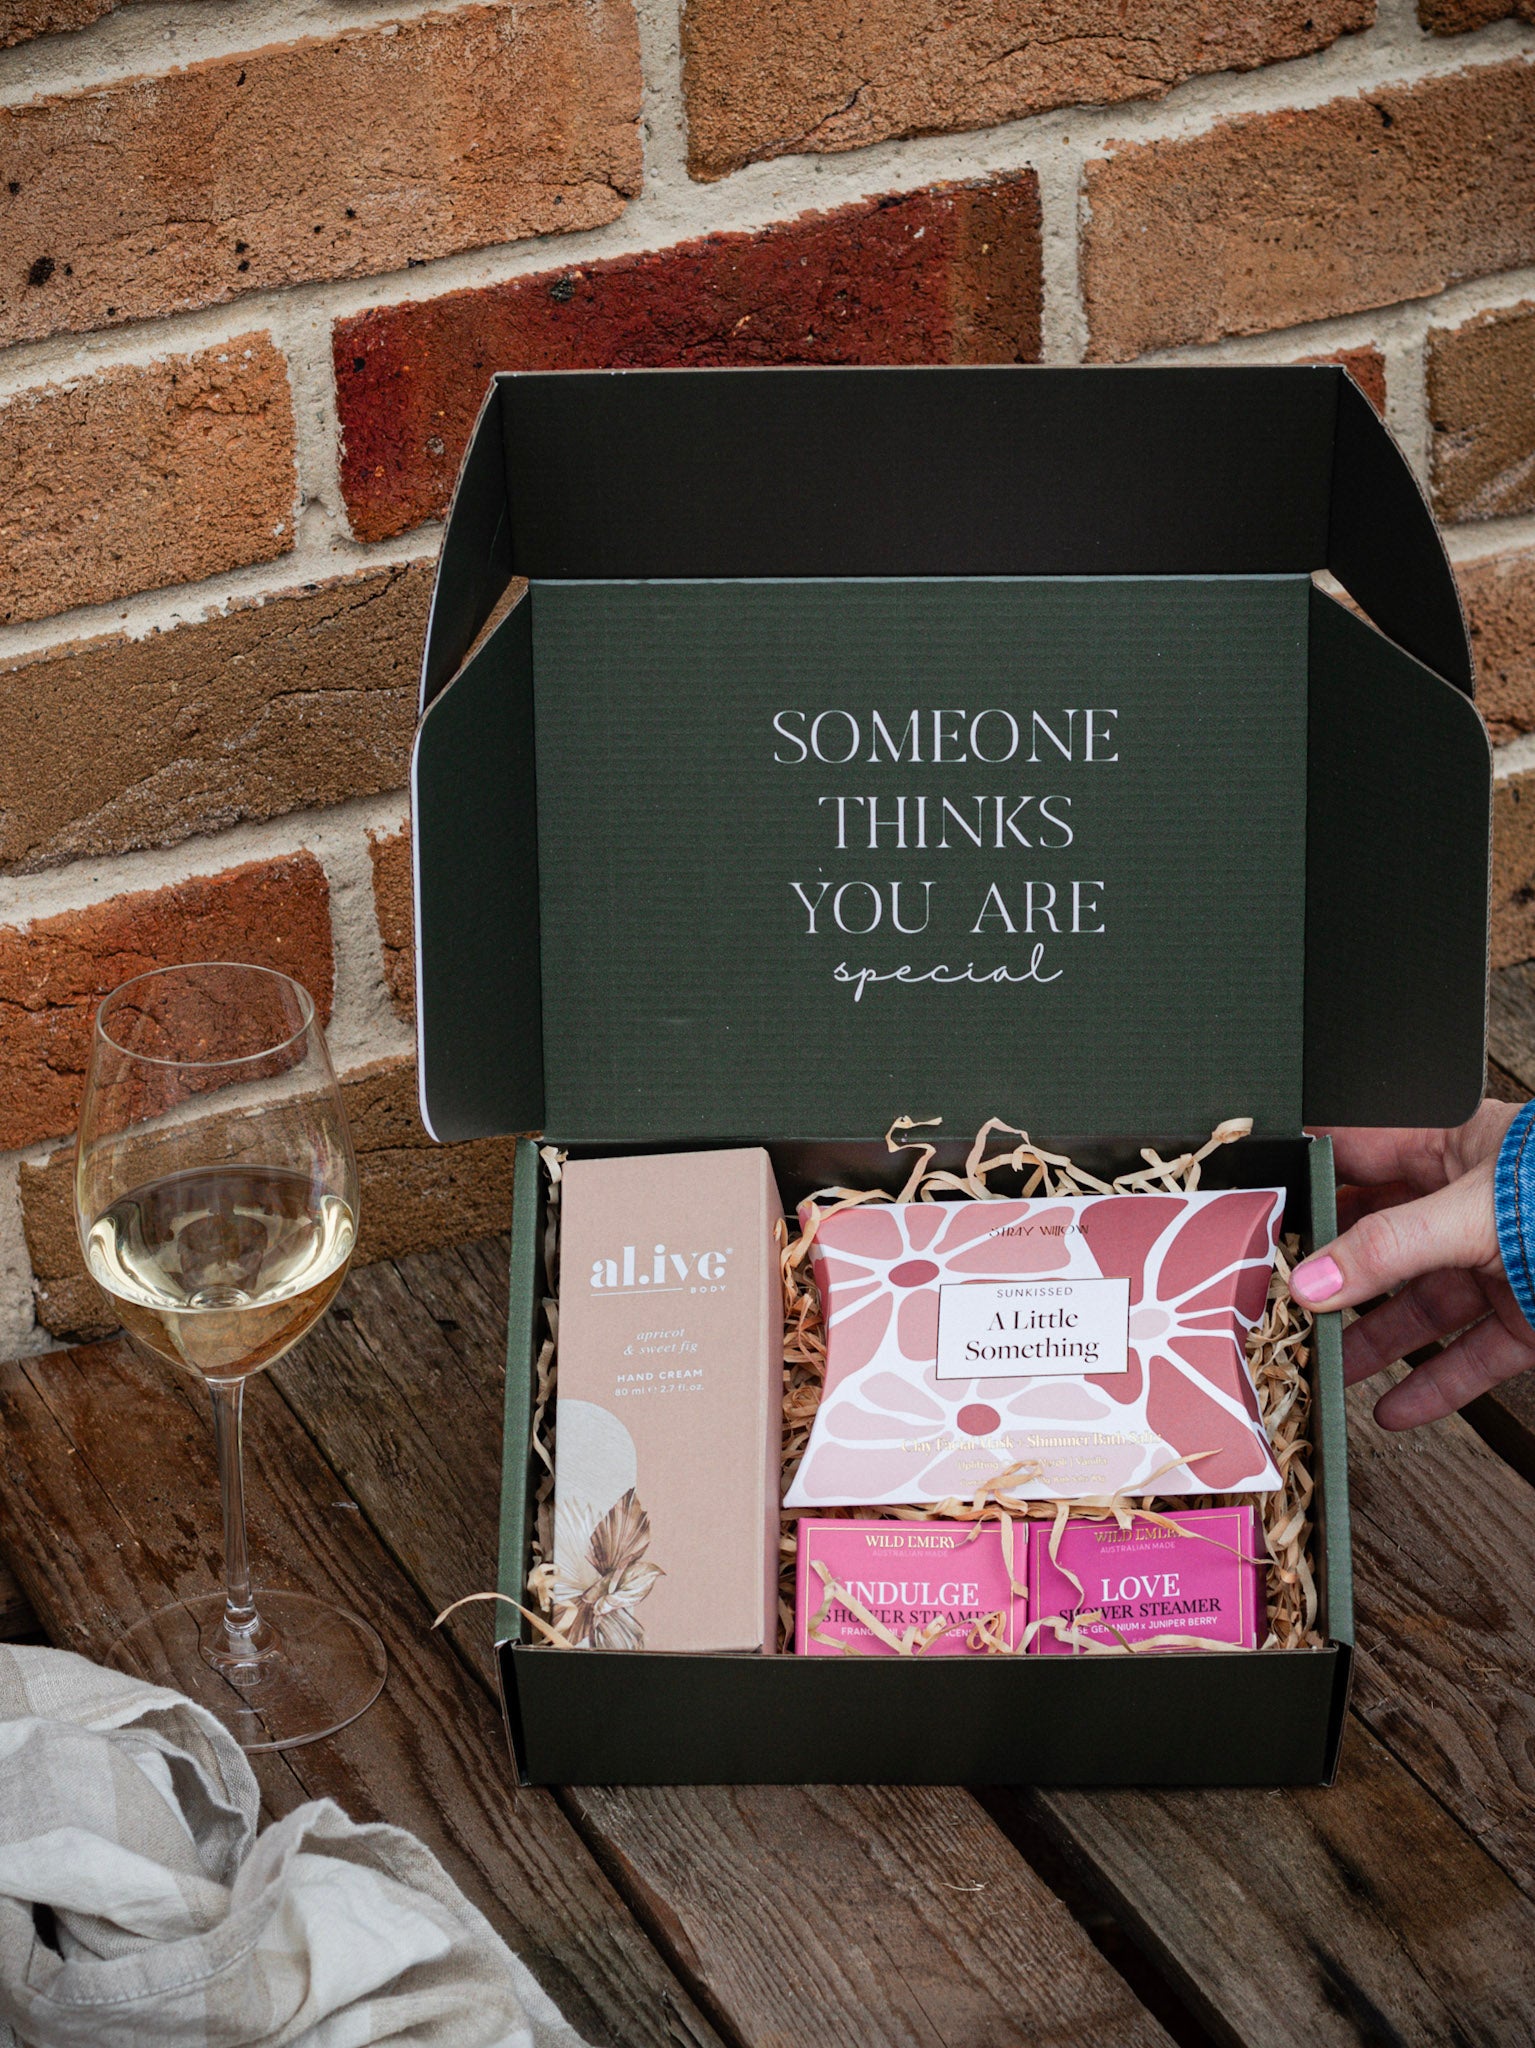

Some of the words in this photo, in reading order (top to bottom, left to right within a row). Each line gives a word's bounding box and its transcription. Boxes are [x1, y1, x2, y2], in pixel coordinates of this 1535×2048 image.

[772, 708, 1119, 763] SOMEONE
[818, 795, 1074, 848] THINKS
[788, 881, 936, 934] YOU
[969, 881, 1105, 933] ARE
[833, 942, 1063, 1002] special
[989, 1226, 1034, 1237] STRAY
[690, 1285, 726, 1294] BODY
[996, 1287, 1073, 1298] SUNKISSED
[987, 1312, 1005, 1331] A
[1013, 1308, 1078, 1330] Little
[636, 1328, 685, 1342] apricot
[623, 1344, 634, 1356] &
[639, 1343, 677, 1355] sweet
[678, 1340, 698, 1354] fig
[964, 1337, 1099, 1363] Something
[617, 1372, 654, 1383] HAND
[658, 1368, 703, 1380] CREAM
[614, 1387, 629, 1397] 80
[631, 1385, 645, 1396] ml
[865, 1535, 905, 1548] WILD
[1094, 1529, 1133, 1544] WILD
[1135, 1526, 1182, 1541] EMER
[1100, 1543, 1151, 1554] AUSTRALIAN
[1152, 1541, 1176, 1550] MADE
[844, 1581, 979, 1606] INDULGE
[1101, 1573, 1180, 1602] LOVE
[1139, 1598, 1222, 1618] STEAMER
[822, 1609, 905, 1624] SHOER
[1148, 1618, 1186, 1630] JUNIPER
[1188, 1616, 1218, 1627] BERRY
[841, 1627, 899, 1636] FRANGNI
